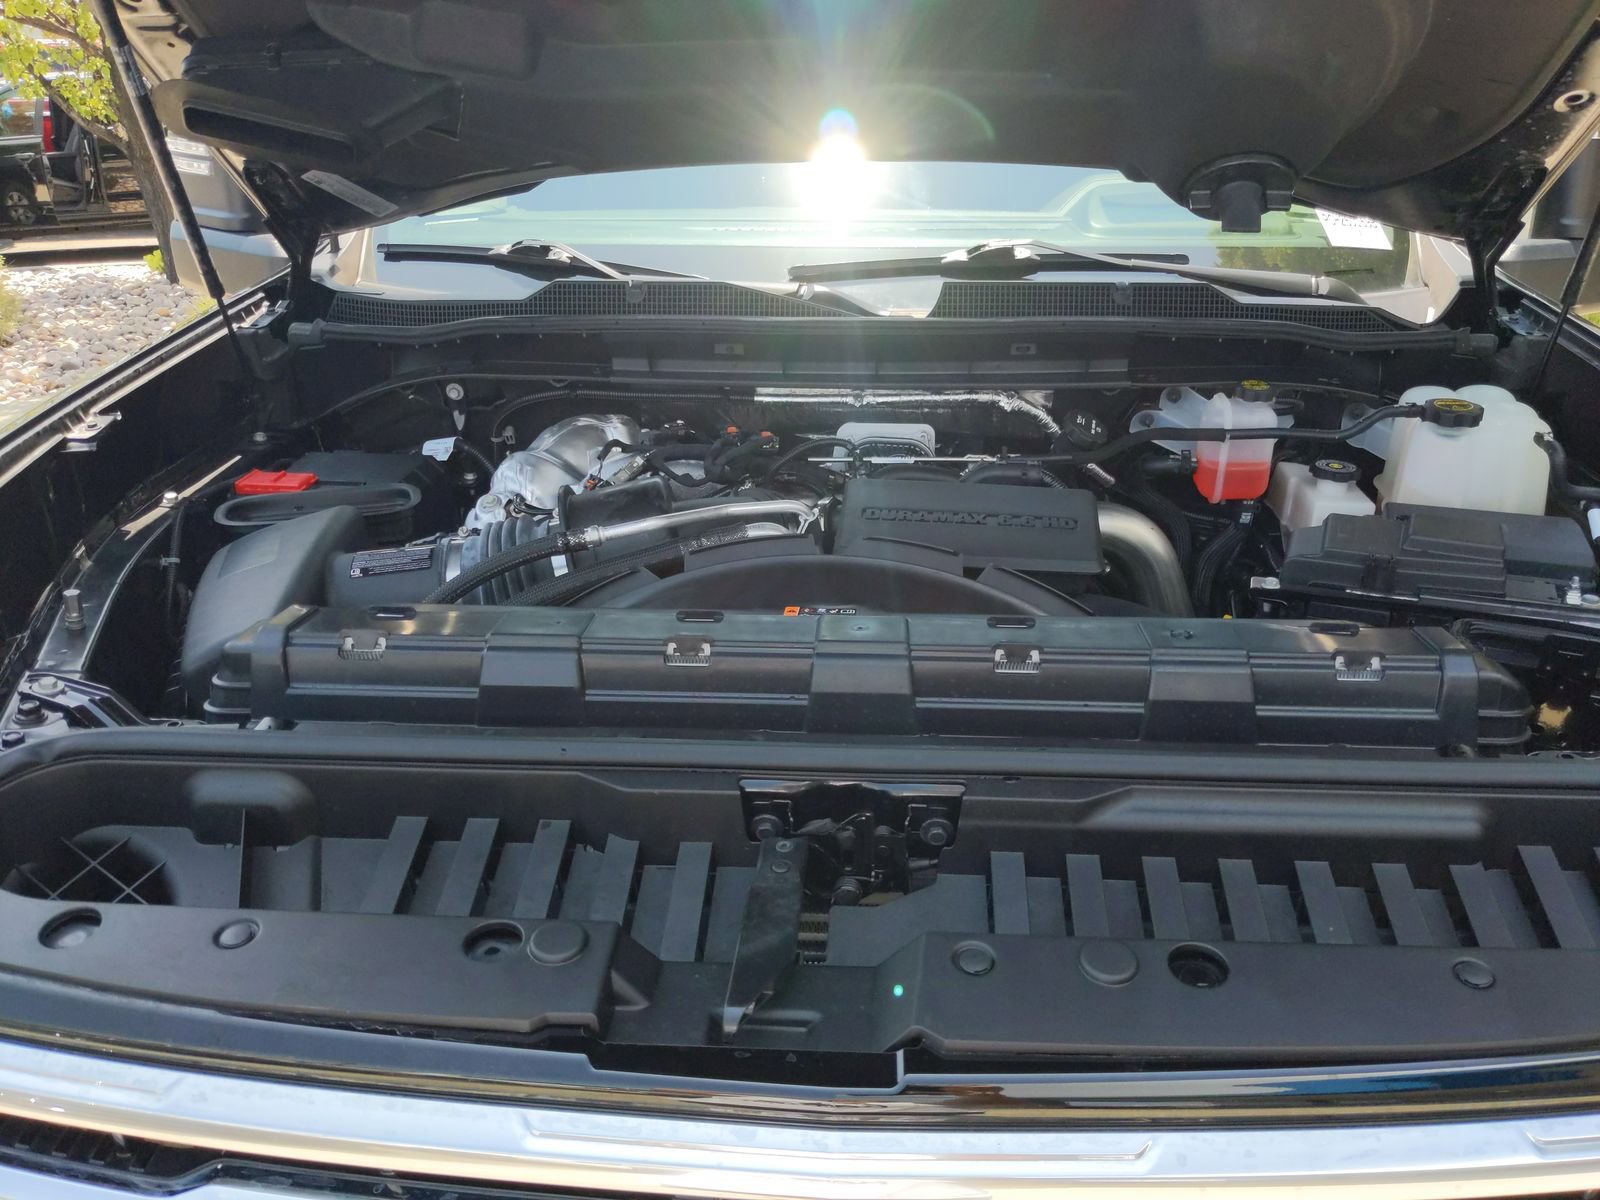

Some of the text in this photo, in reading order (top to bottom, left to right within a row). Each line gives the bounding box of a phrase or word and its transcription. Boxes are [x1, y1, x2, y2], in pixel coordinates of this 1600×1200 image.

[862, 508, 1080, 530] DURAMAX 6.6 HD
